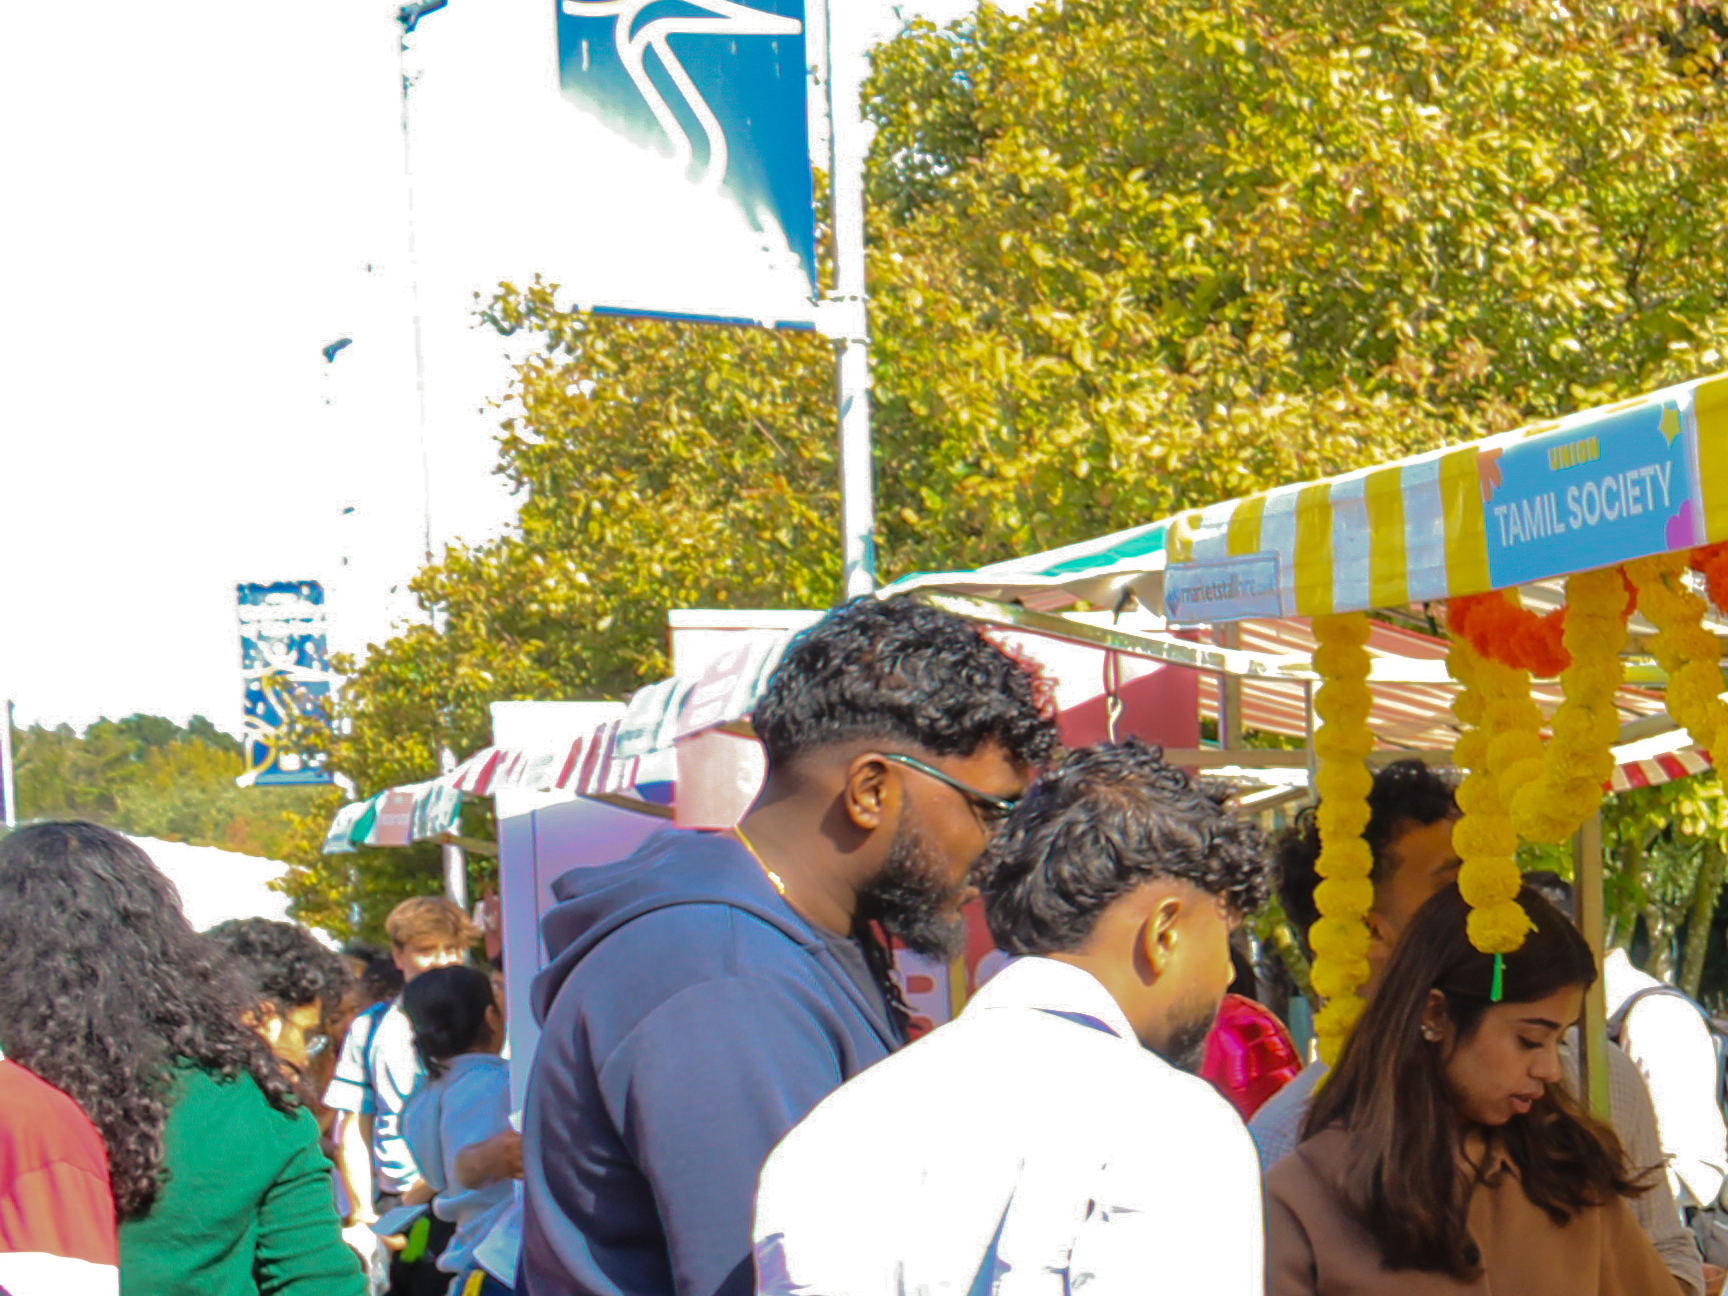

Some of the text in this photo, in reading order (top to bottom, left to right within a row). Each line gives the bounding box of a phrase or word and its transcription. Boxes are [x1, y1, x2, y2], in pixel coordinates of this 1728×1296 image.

[1548, 436, 1600, 471] UNION
[1494, 461, 1672, 546] TAMIL SOCIETY
